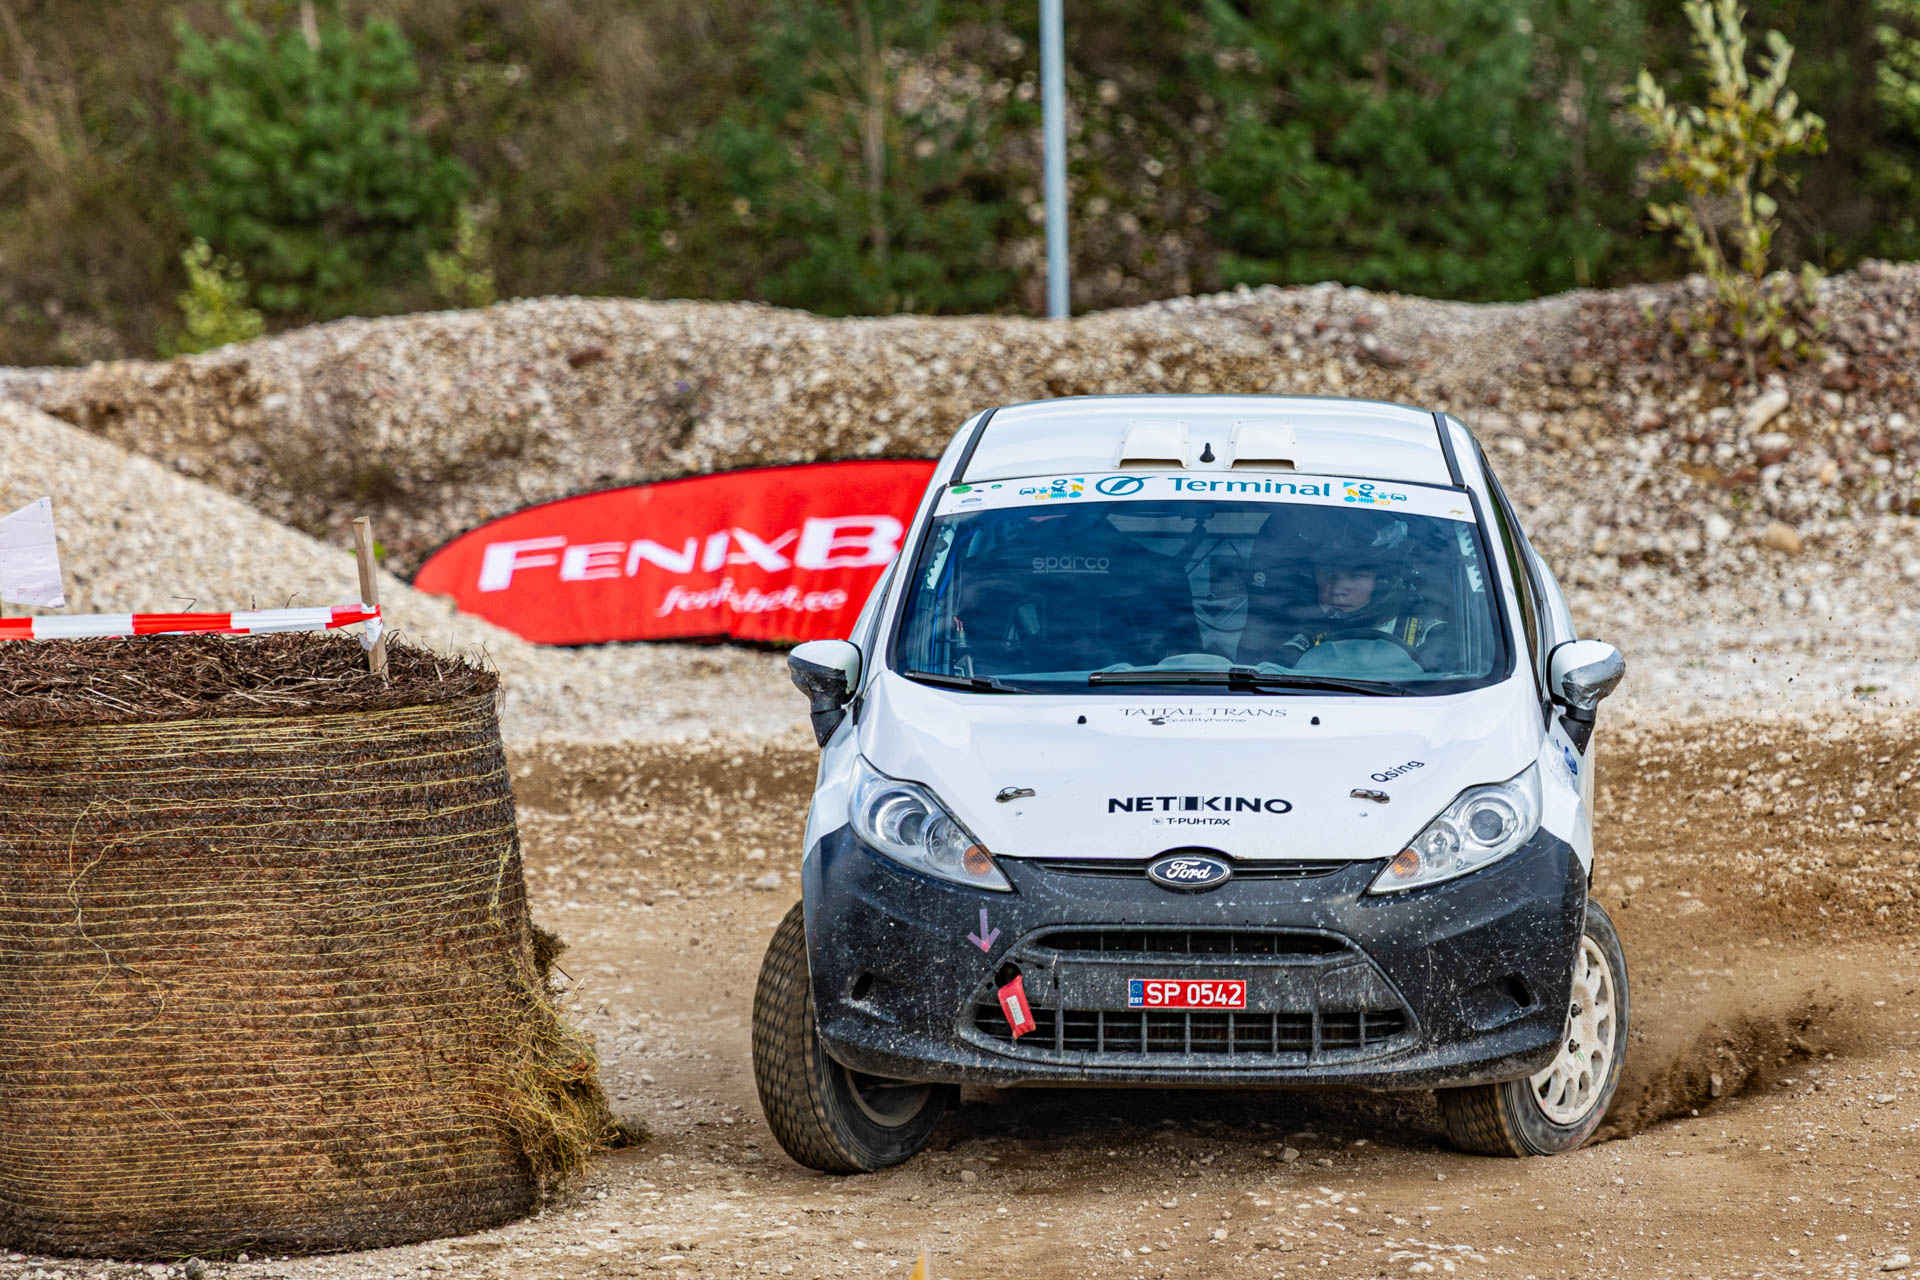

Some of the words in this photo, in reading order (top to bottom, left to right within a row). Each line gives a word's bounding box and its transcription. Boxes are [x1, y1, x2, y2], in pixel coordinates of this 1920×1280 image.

[1168, 477, 1330, 497] Terminal
[1032, 556, 1110, 575] sparco
[1119, 708, 1201, 716] TAITAL
[1208, 708, 1288, 717] TRANS
[1370, 760, 1425, 782] Qsing
[1166, 817, 1231, 826] T-PUHTAX
[1166, 860, 1212, 879] Ford
[1146, 983, 1181, 1005] SP
[1187, 983, 1242, 1006] 0542
